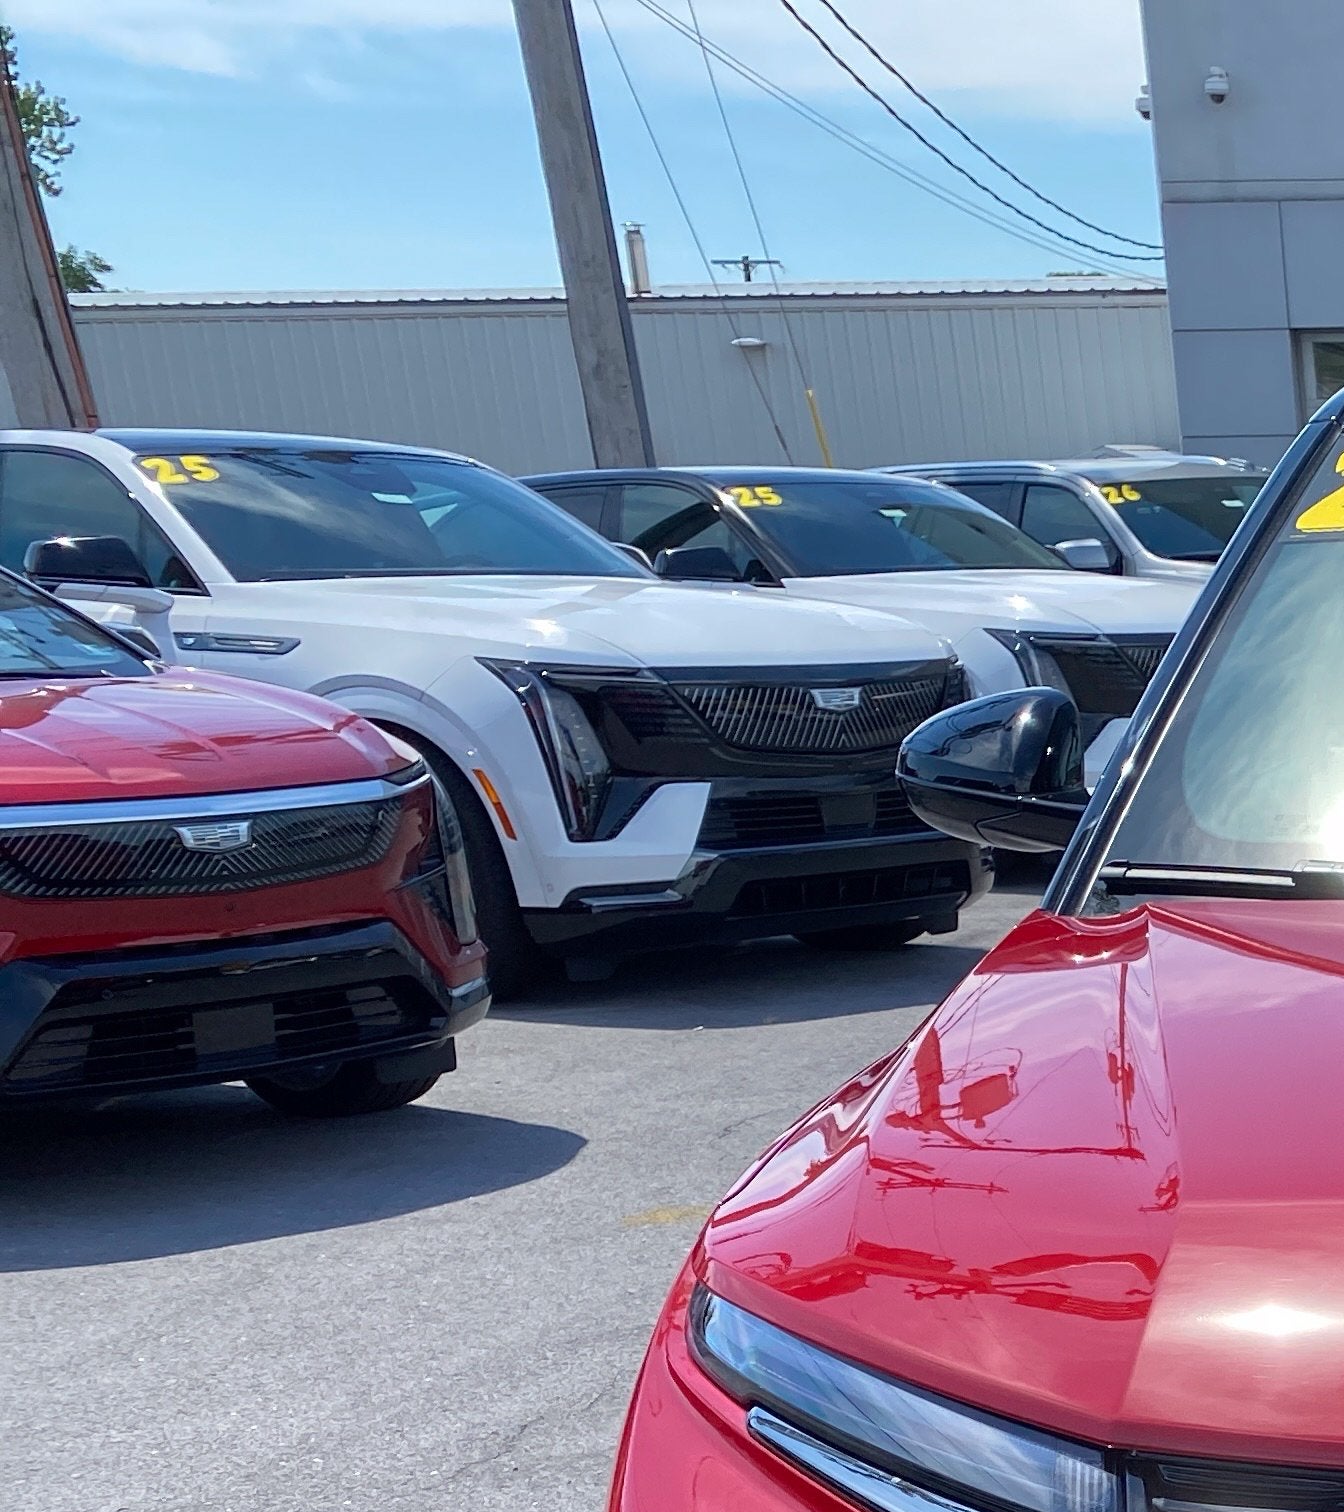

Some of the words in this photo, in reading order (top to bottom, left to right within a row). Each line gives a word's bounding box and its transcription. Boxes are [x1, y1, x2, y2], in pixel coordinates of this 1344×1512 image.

[140, 455, 220, 485] 25
[730, 486, 783, 507] 25
[1100, 483, 1142, 504] 26
